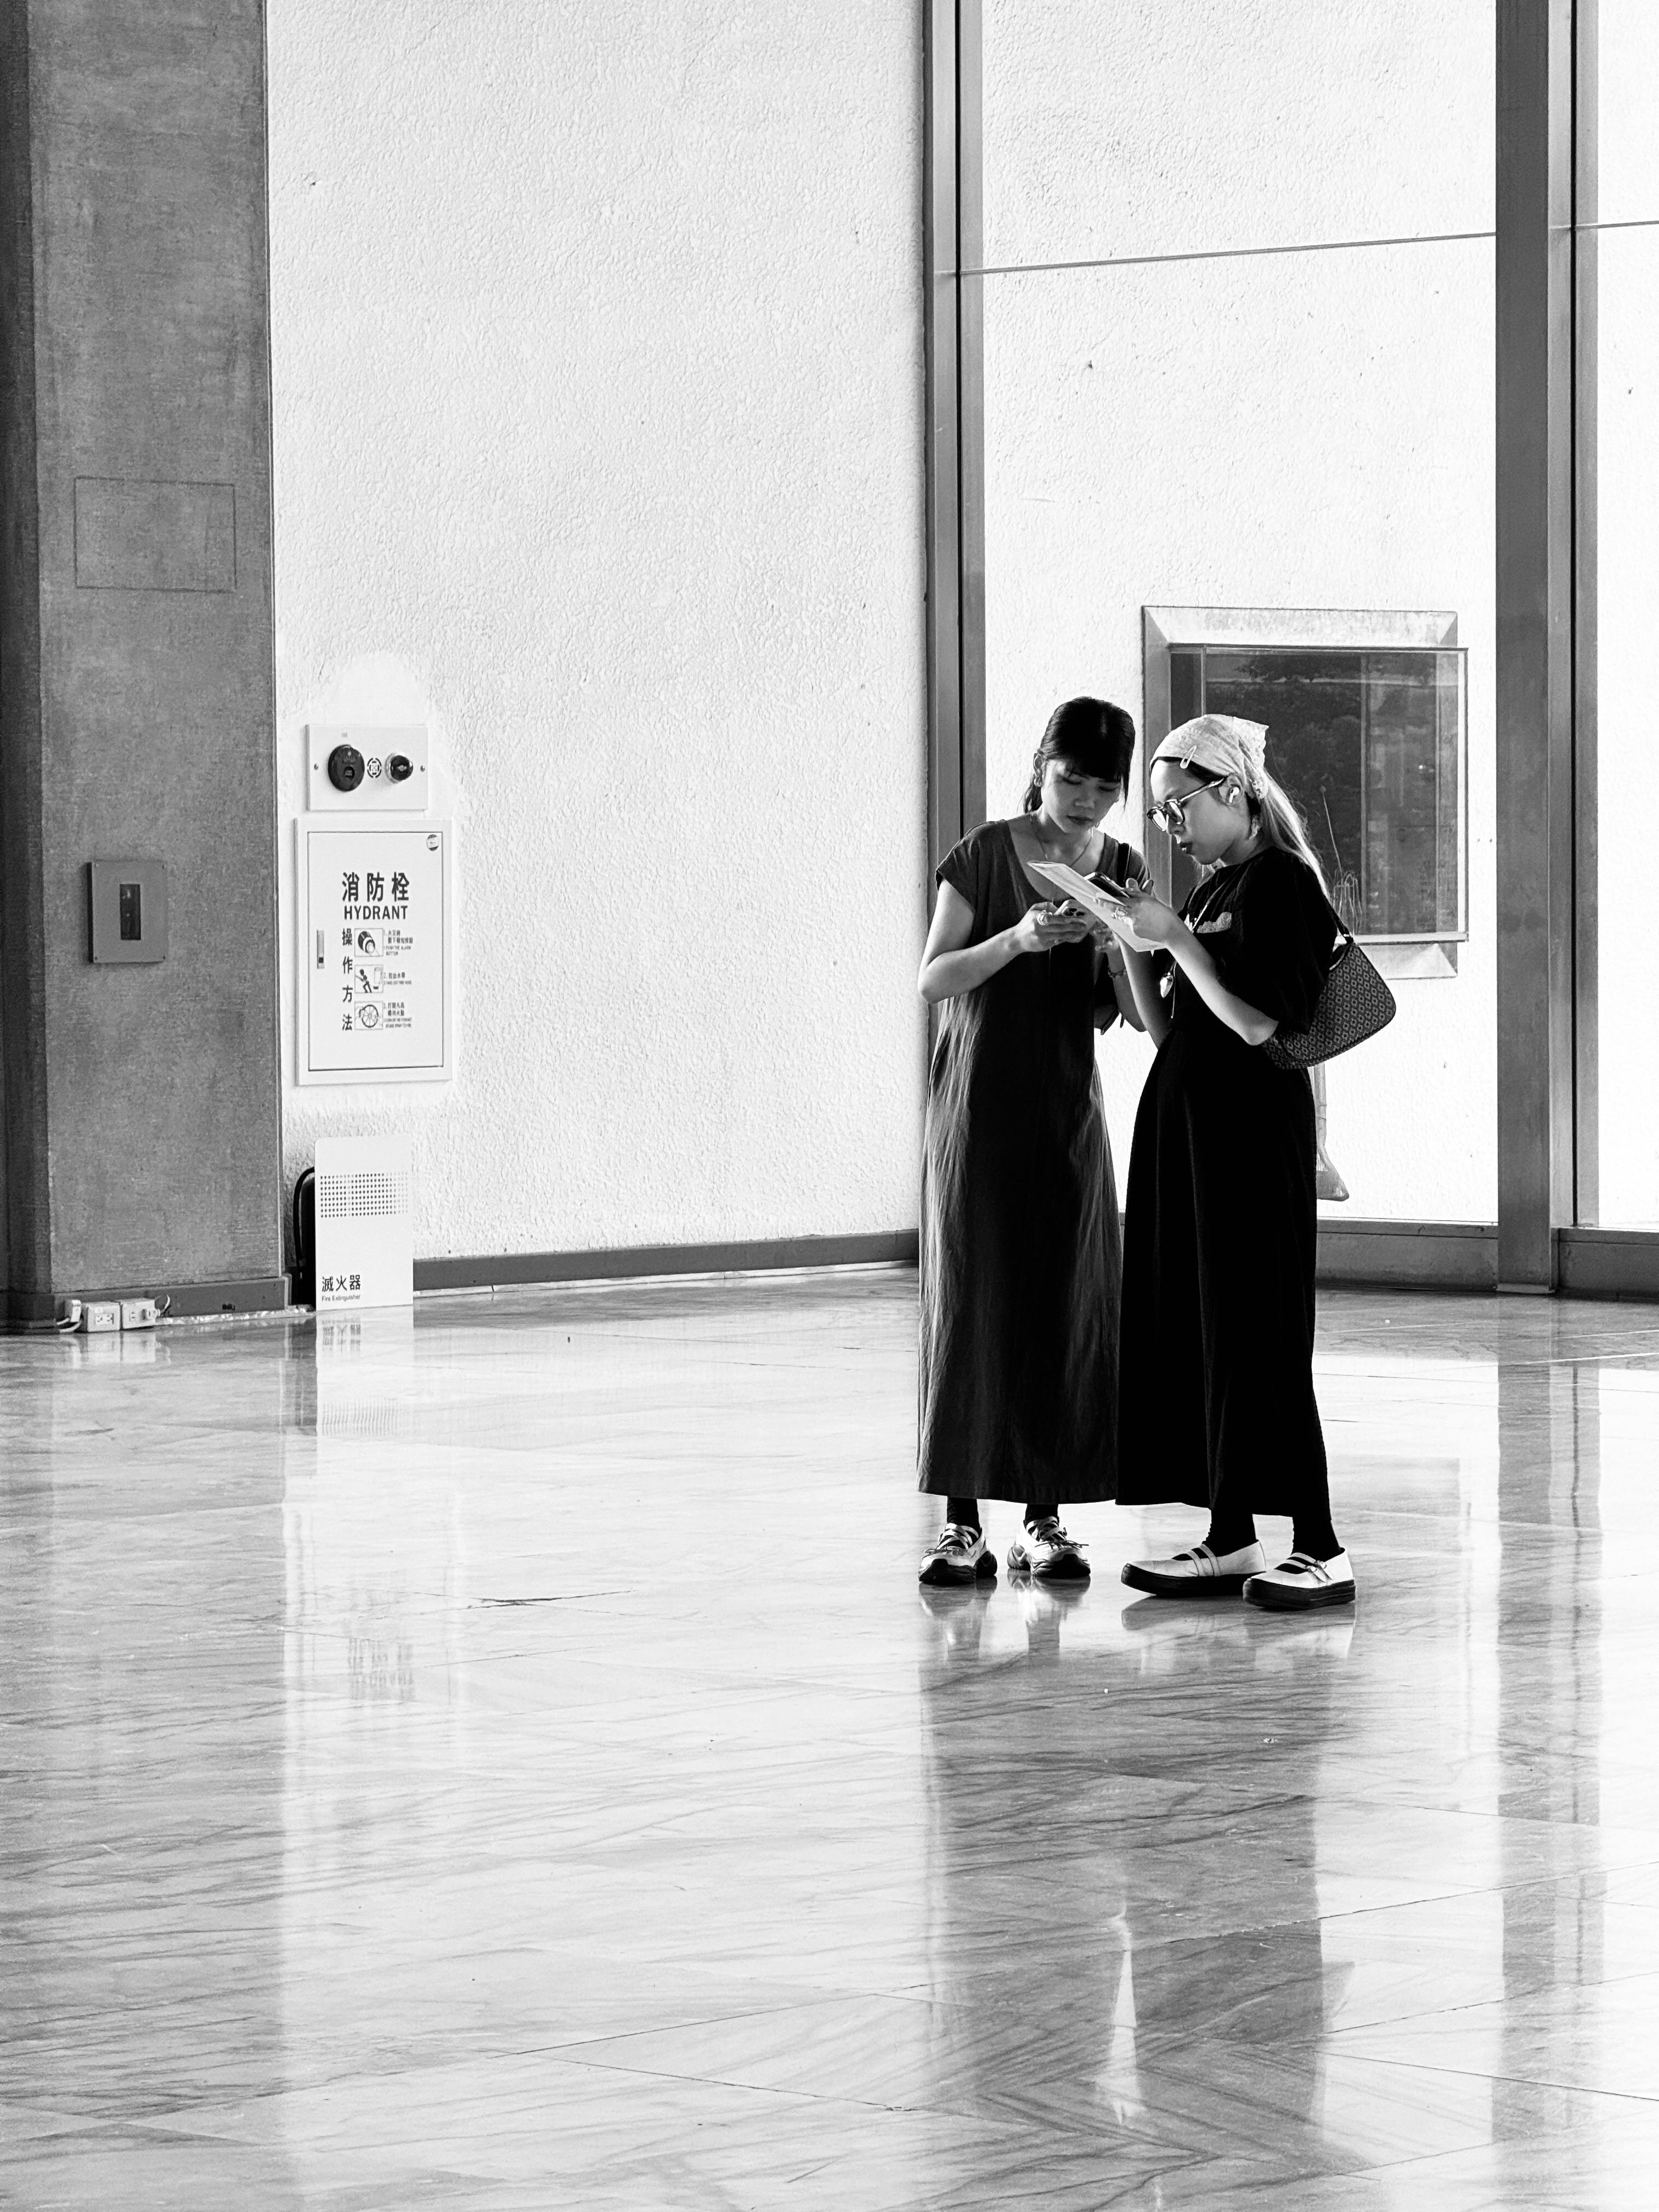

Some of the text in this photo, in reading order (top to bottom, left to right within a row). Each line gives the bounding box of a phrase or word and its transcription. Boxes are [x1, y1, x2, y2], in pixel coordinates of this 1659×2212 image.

[342, 871, 410, 902] 消防栓
[344, 905, 408, 919] HYDRANT
[342, 928, 353, 1031] 操作方法
[322, 1275, 360, 1292] 滅火器
